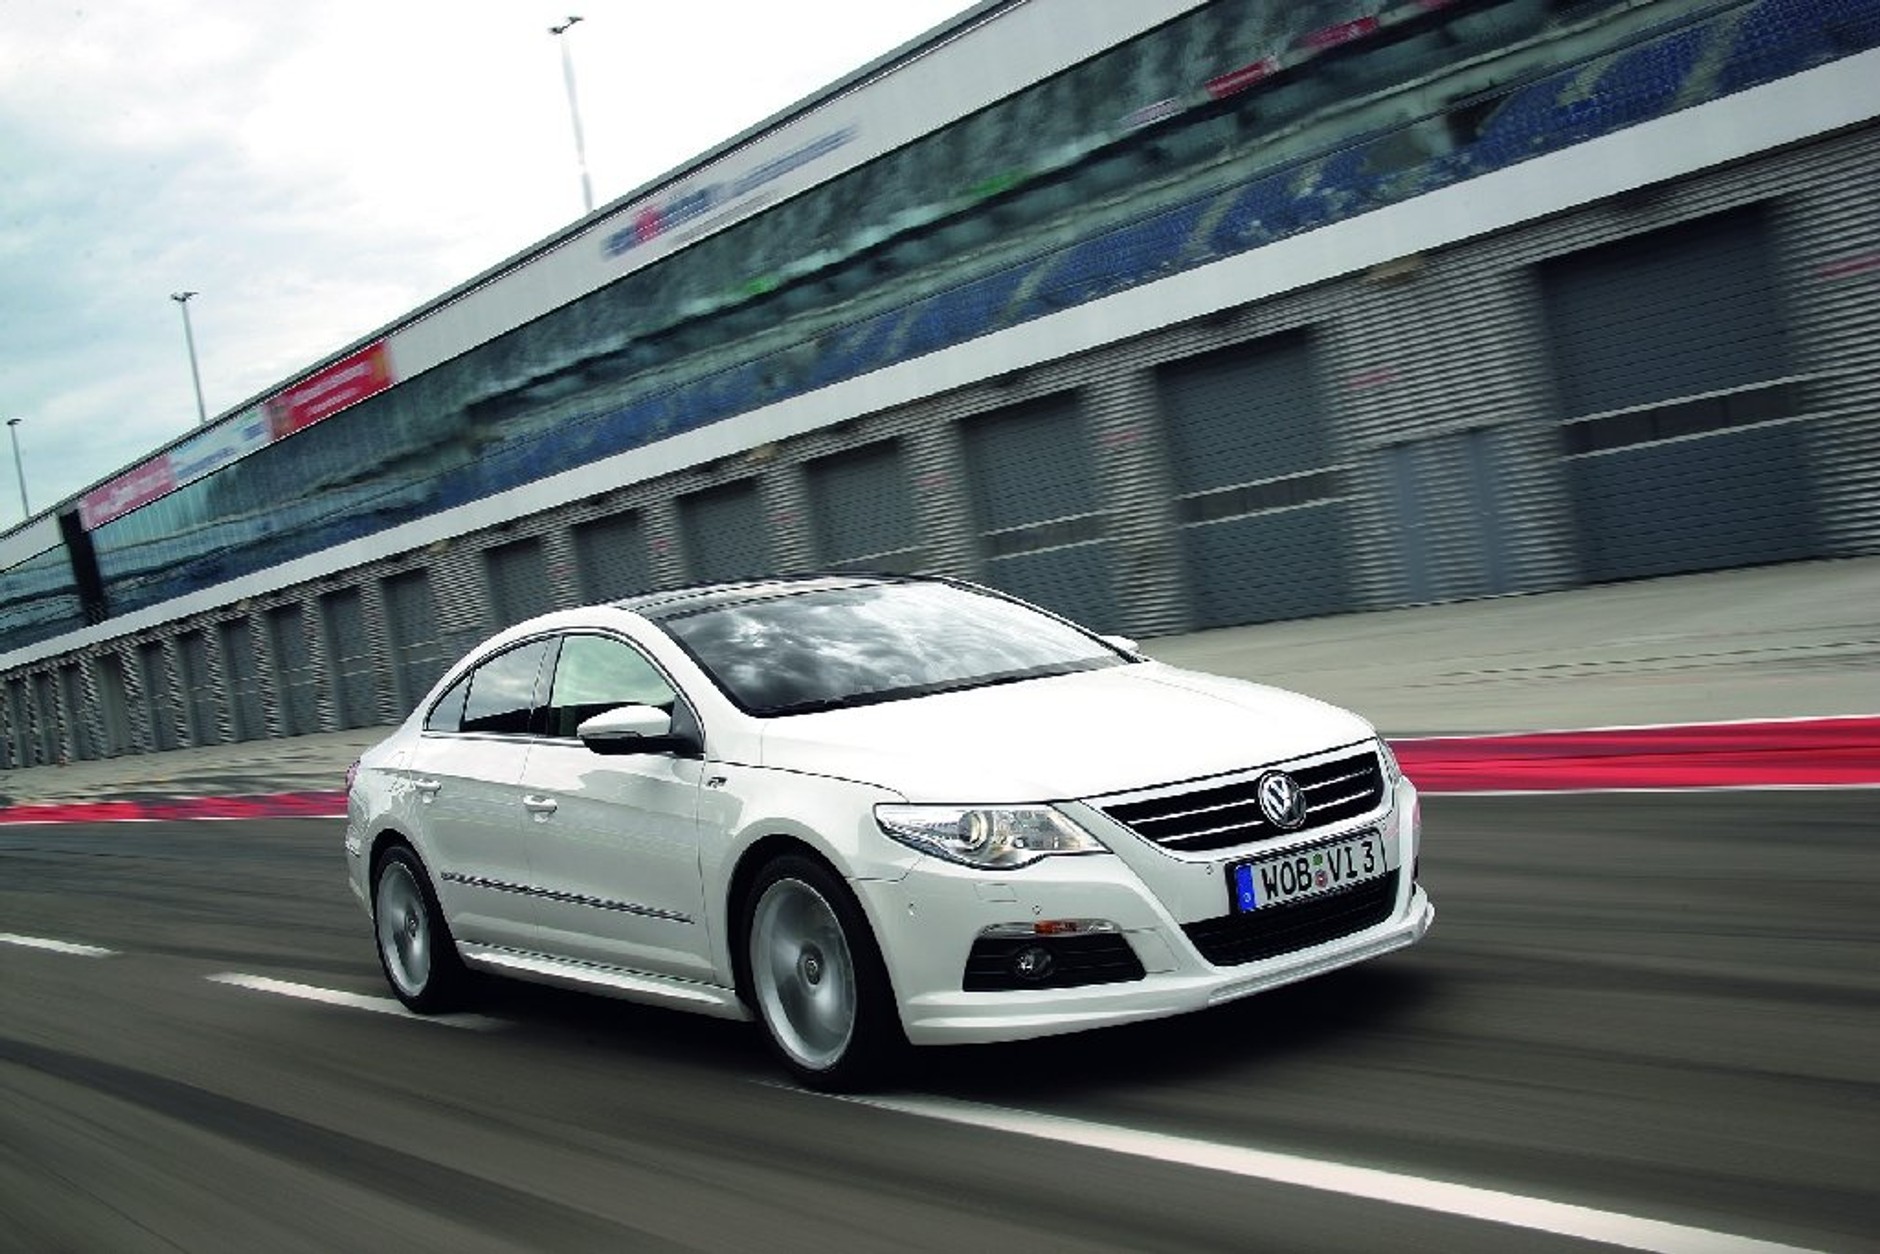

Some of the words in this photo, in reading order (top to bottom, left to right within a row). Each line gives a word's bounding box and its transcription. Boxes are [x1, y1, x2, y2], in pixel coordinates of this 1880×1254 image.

[1261, 857, 1312, 900] WOB
[1327, 846, 1358, 882] VI
[1361, 841, 1375, 873] 3
